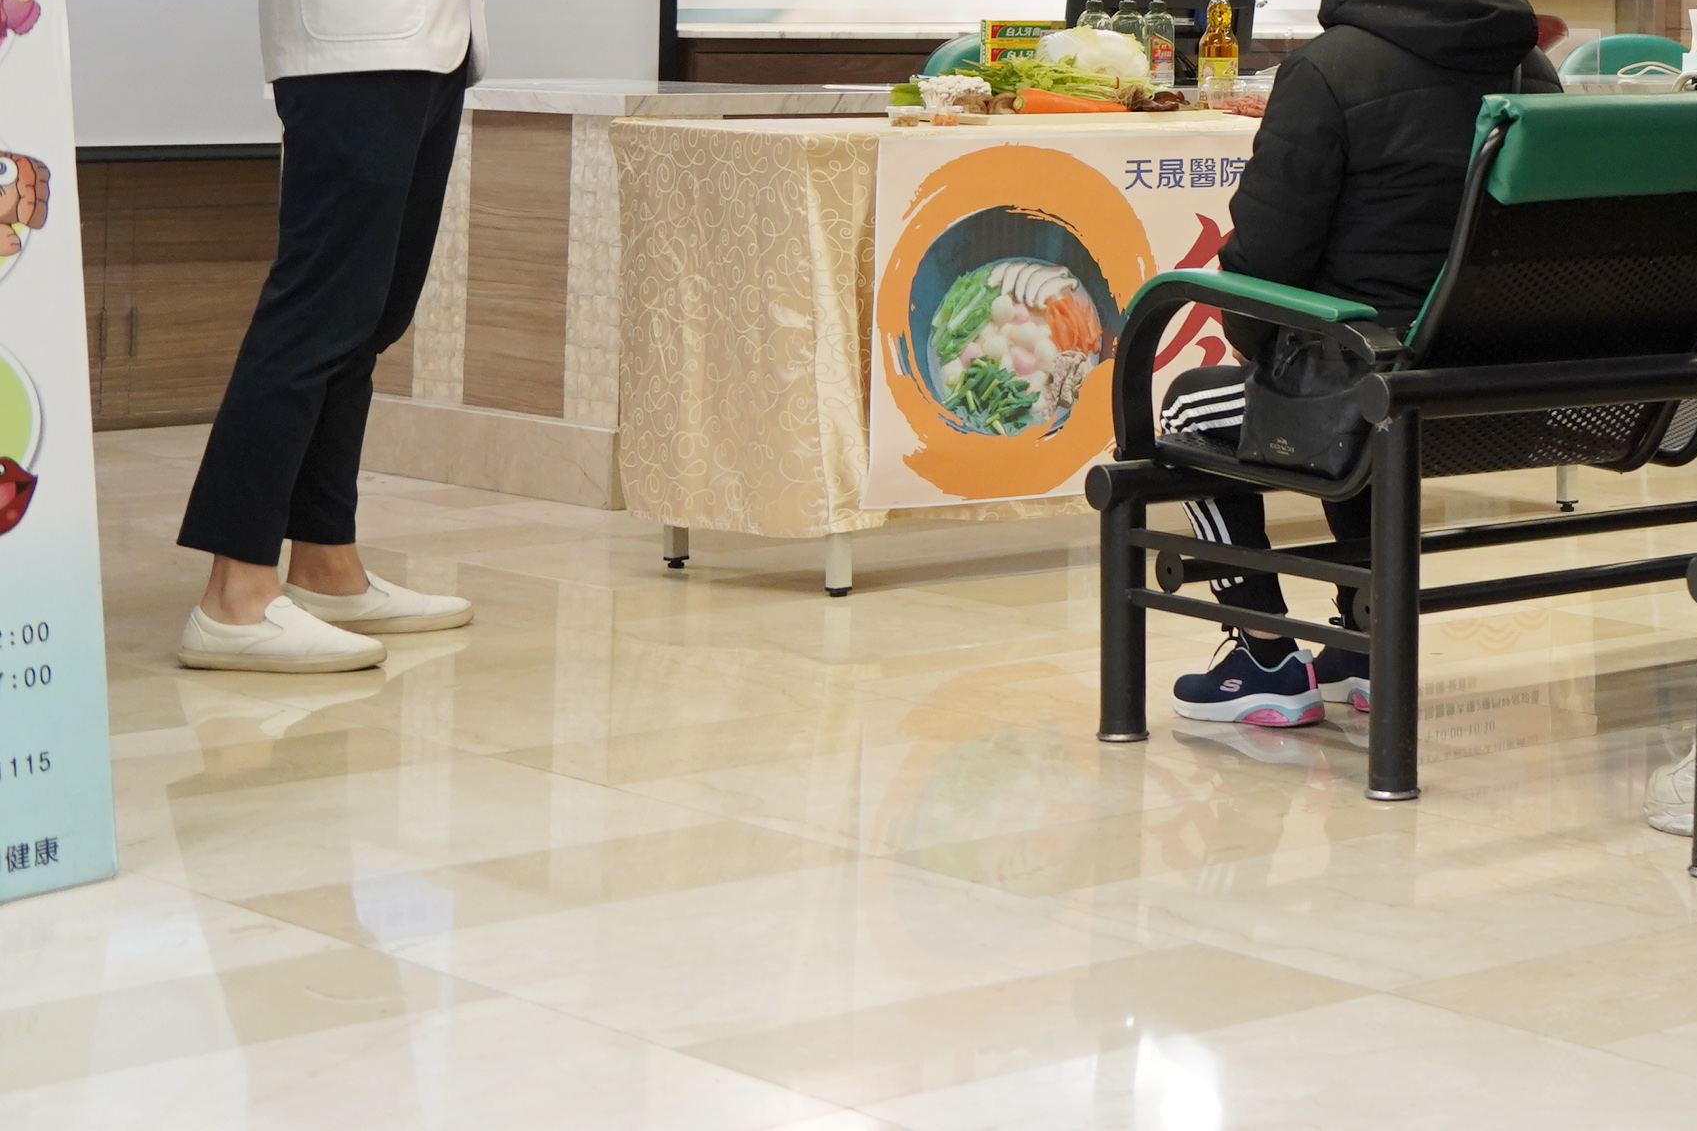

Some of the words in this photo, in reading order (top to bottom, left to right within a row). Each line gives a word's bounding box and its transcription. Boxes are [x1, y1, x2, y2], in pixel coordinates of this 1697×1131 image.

[1125, 157, 1249, 190] 天晟醫院
[0, 621, 49, 647] :00
[0, 664, 51, 689] :00
[5, 836, 59, 873] 健康
